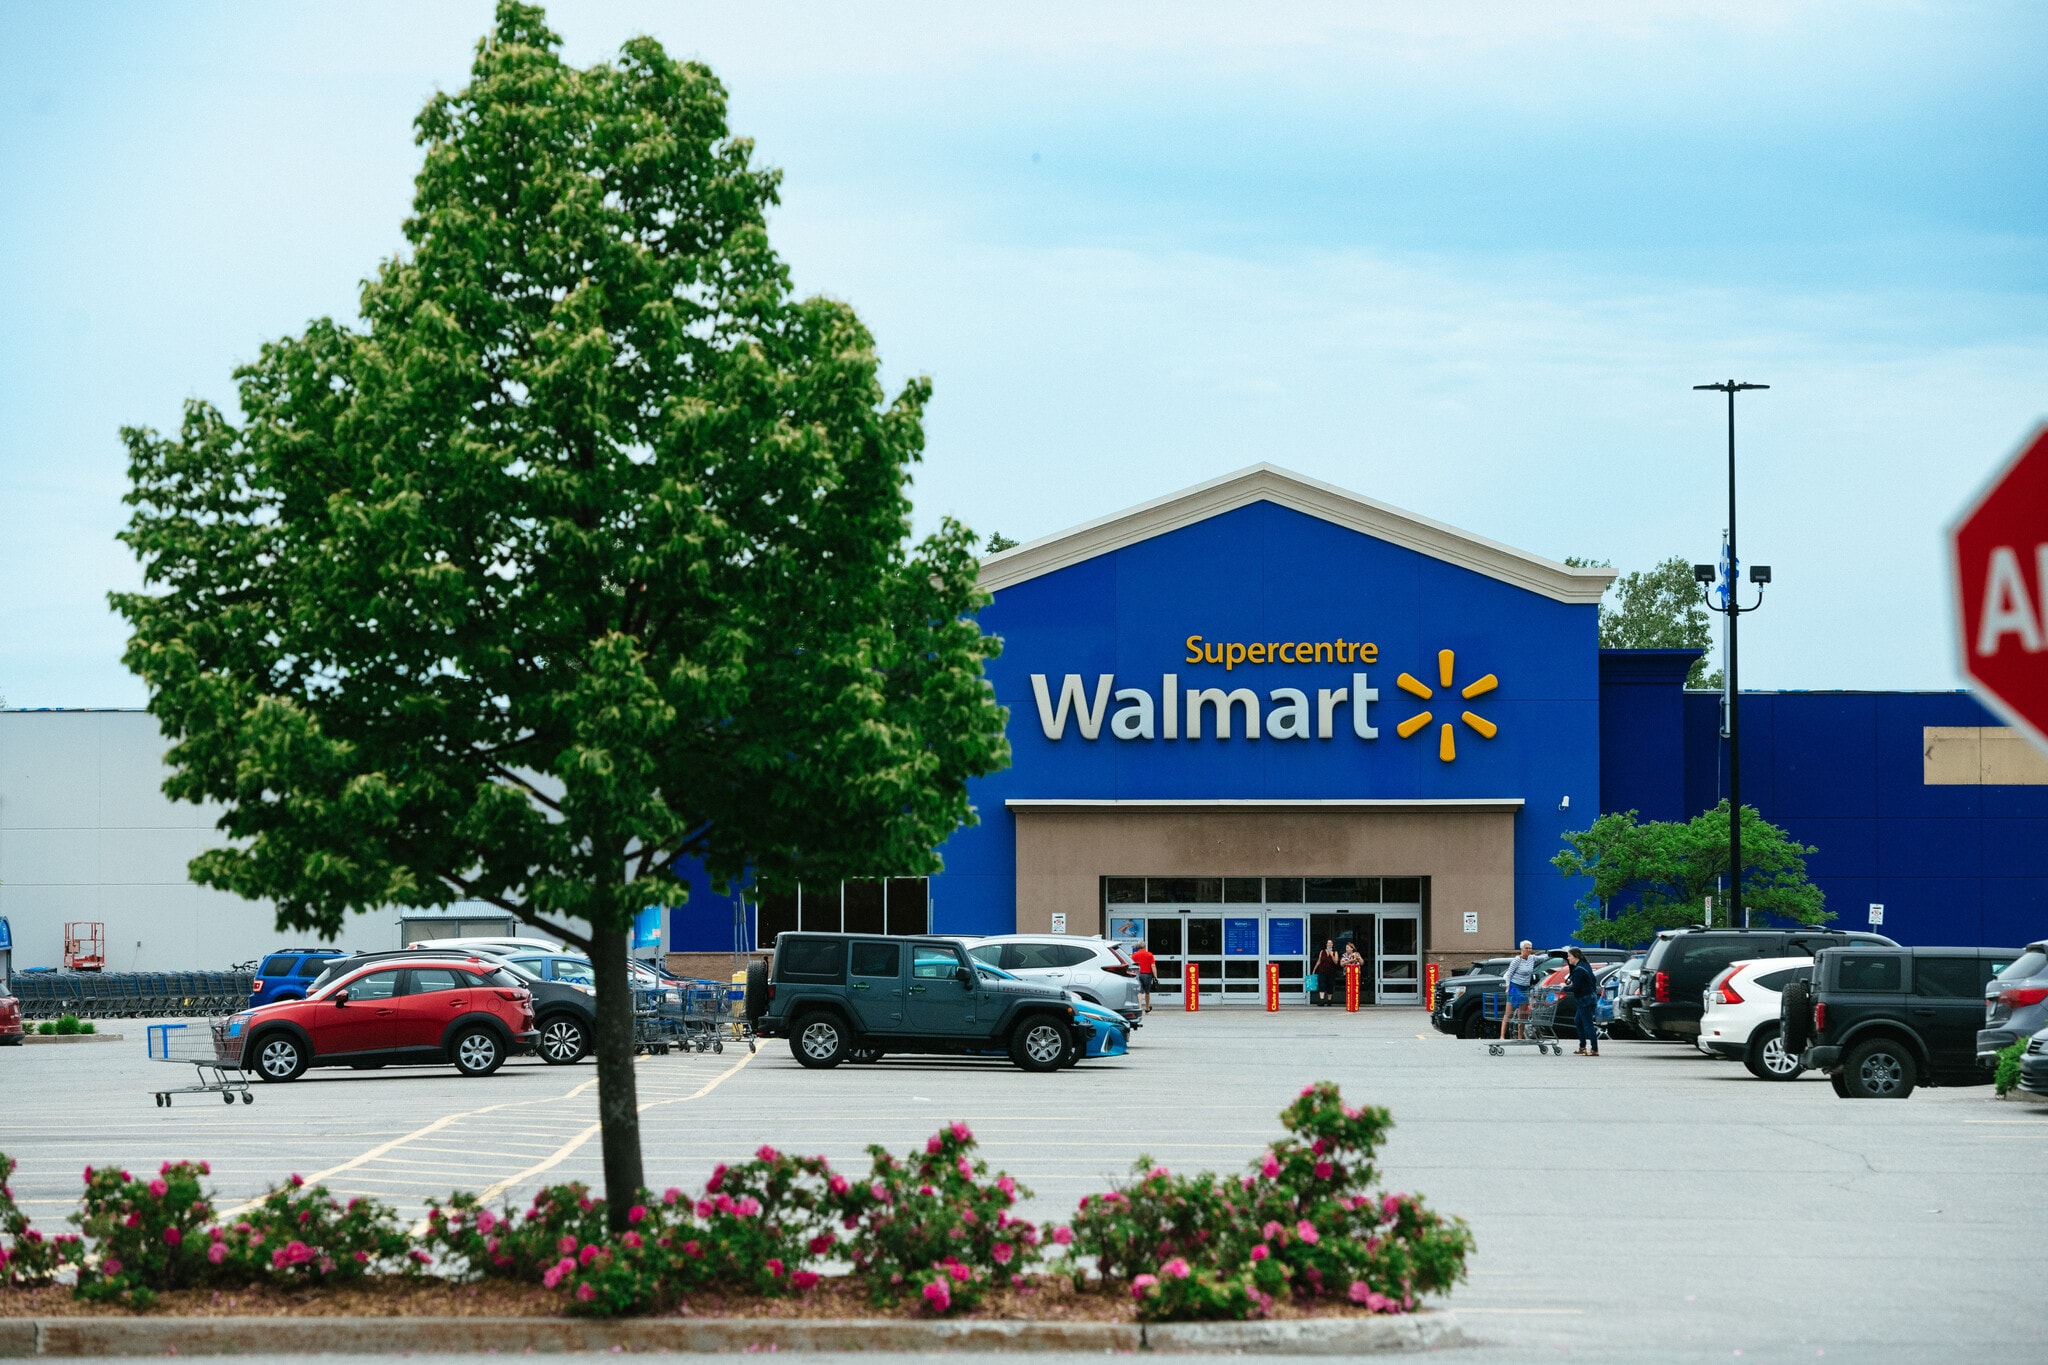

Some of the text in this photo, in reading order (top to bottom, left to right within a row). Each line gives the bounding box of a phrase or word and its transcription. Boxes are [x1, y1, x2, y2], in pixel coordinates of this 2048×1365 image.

[1976, 543, 2048, 656] A
[1185, 635, 1379, 671] Supercentre
[1030, 673, 1379, 740] Walmart
[1002, 986, 1050, 995] RUBICON
[1190, 985, 1196, 993] de
[1271, 985, 1276, 993] de
